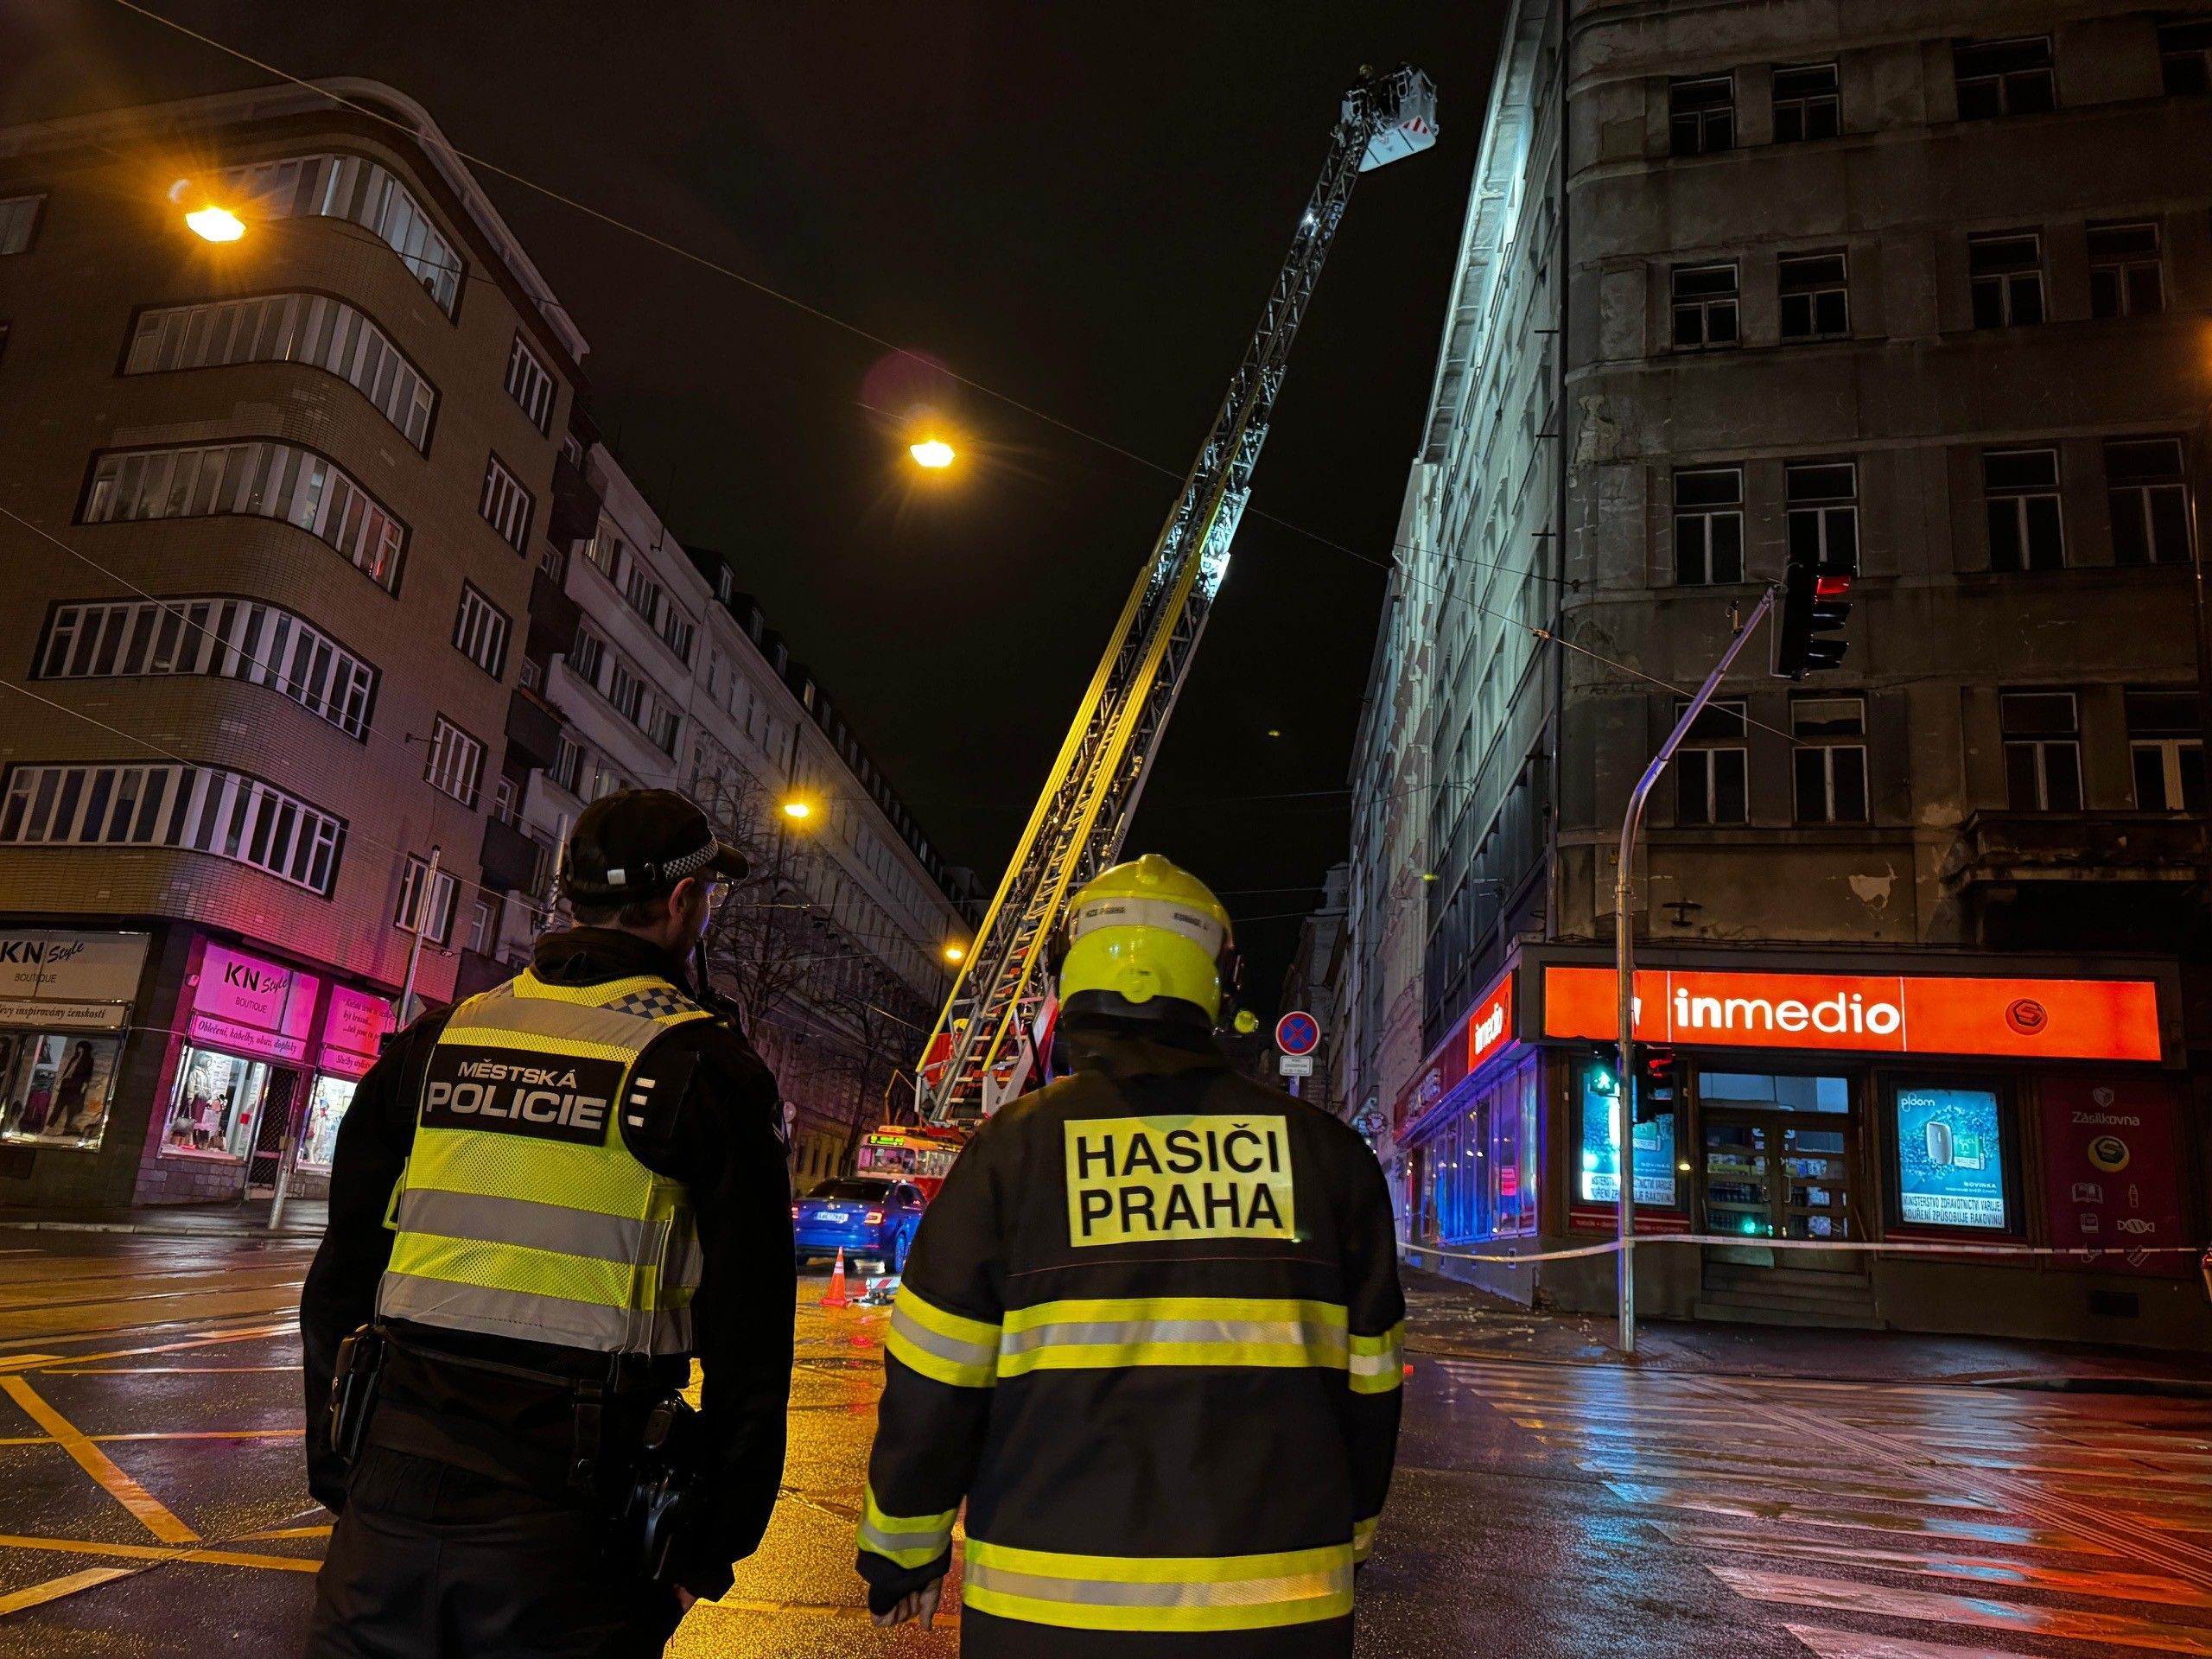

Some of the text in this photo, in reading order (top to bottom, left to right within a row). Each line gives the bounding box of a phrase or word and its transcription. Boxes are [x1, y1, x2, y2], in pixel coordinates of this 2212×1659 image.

[0, 940, 84, 963] KN Style
[14, 973, 57, 983] BOUTIQUE
[224, 961, 288, 994] KN Style
[235, 996, 267, 1014] BOUTIQUE
[1674, 988, 1900, 1034] inmedio
[457, 1058, 577, 1089] MĚSTSKÁ
[426, 1081, 607, 1130] POLICIE
[1901, 1093, 1936, 1112] ploom
[2072, 1111, 2140, 1126] Zásilkovna
[1077, 1123, 1280, 1179] HASIČI
[1078, 1182, 1284, 1236] PRAHA
[1903, 1195, 1940, 1208] MINISTERSTVO
